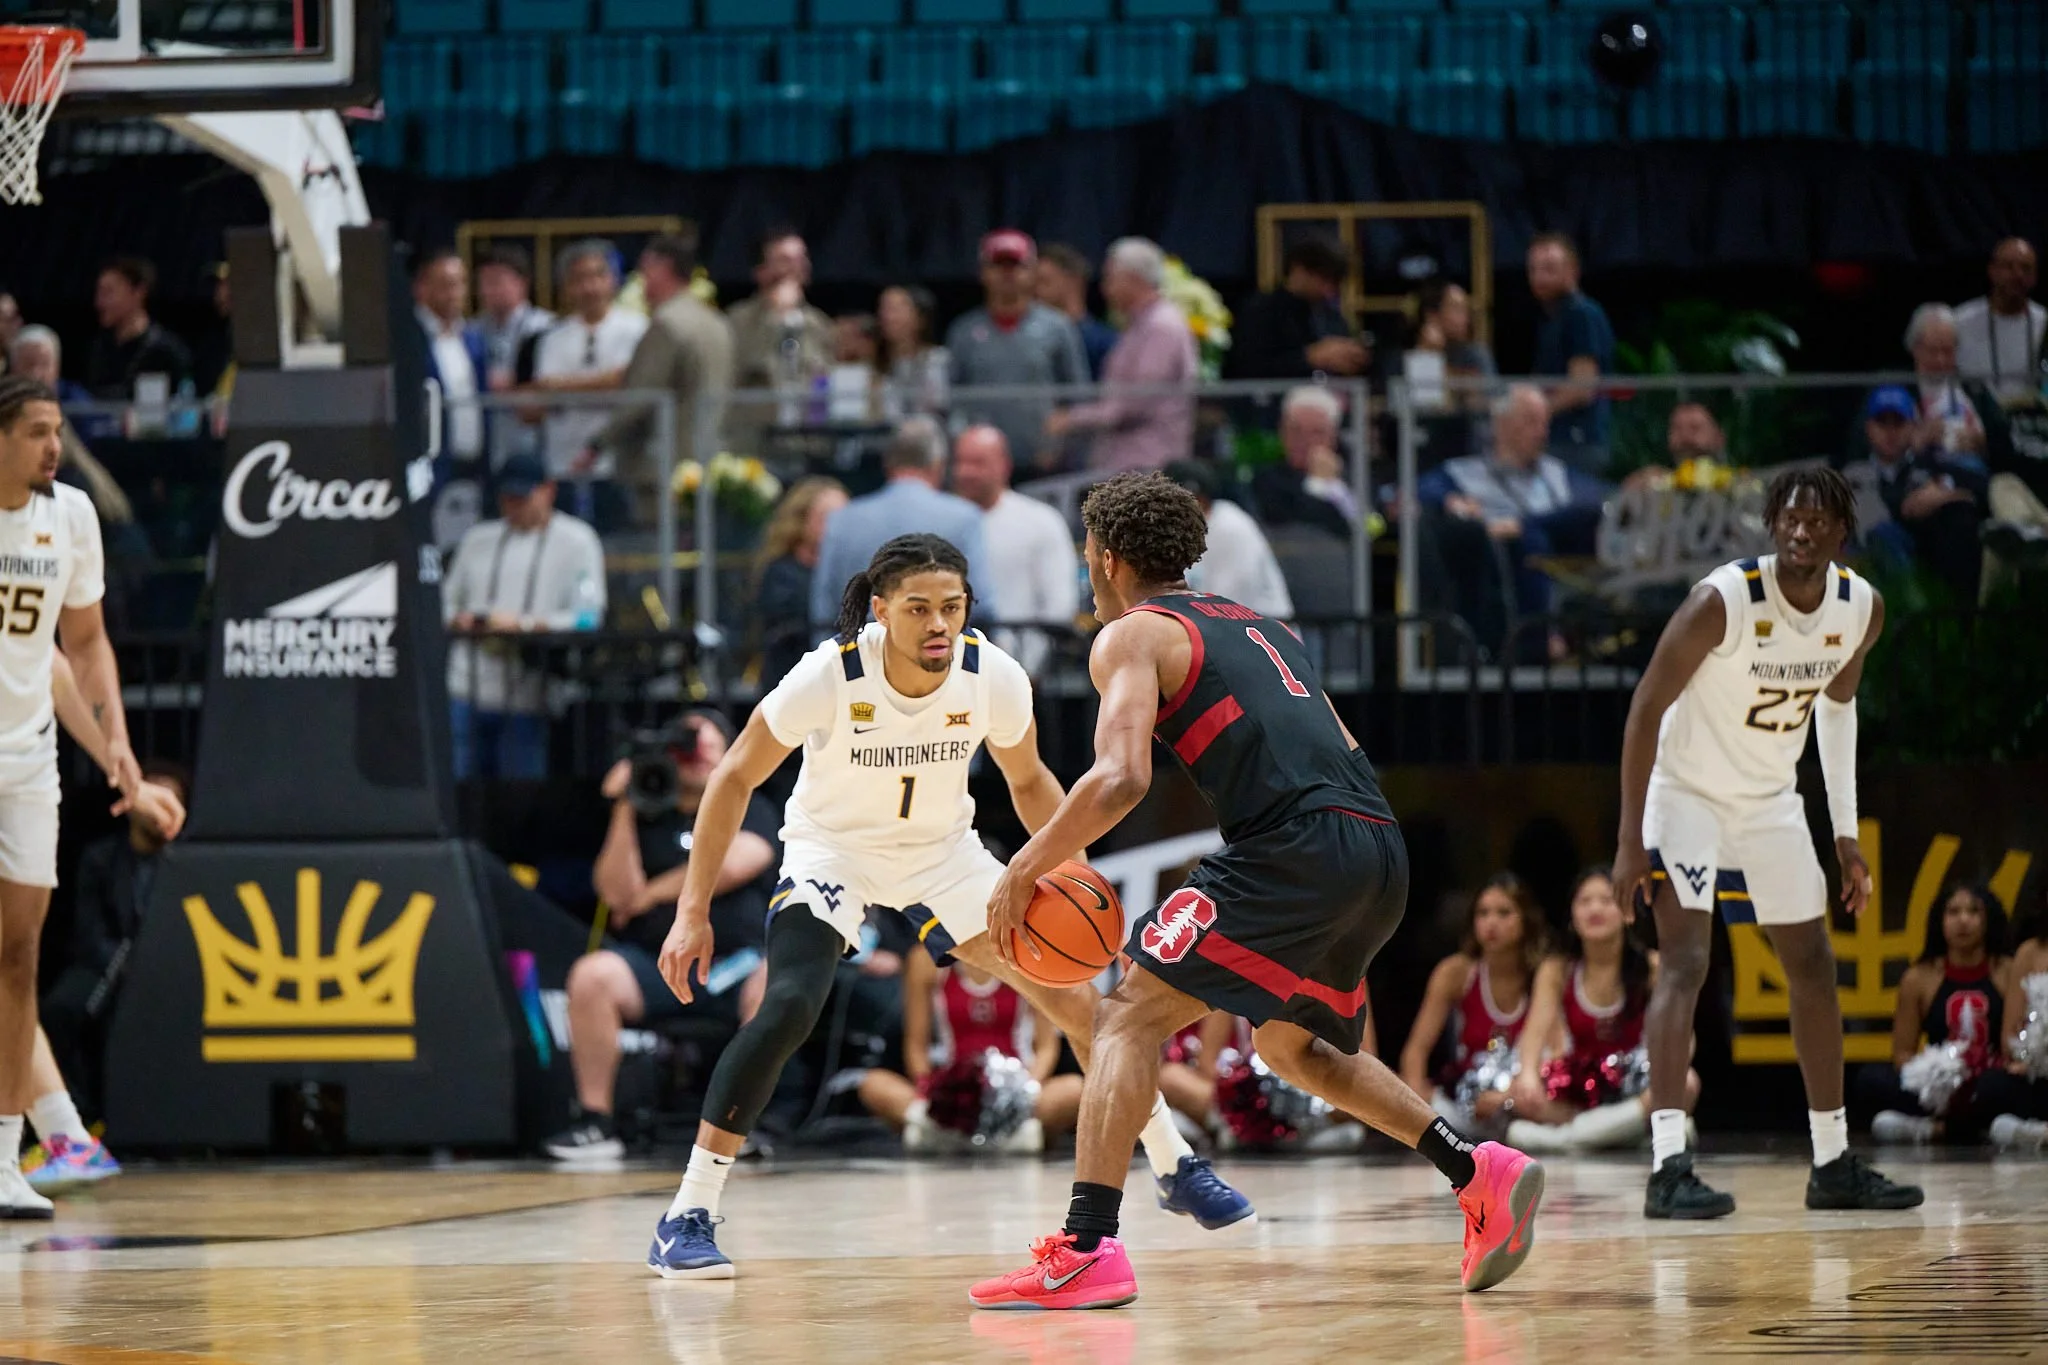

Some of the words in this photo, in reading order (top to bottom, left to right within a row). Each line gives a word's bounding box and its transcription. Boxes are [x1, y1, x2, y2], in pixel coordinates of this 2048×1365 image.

[223, 440, 400, 538] Circa
[224, 618, 396, 649] MERCURY
[224, 649, 398, 677] INSURANCE
[1246, 626, 1311, 697] 1
[1744, 686, 1822, 732] 23
[850, 740, 970, 767] MOUNTAINEERS
[899, 775, 916, 819] 1
